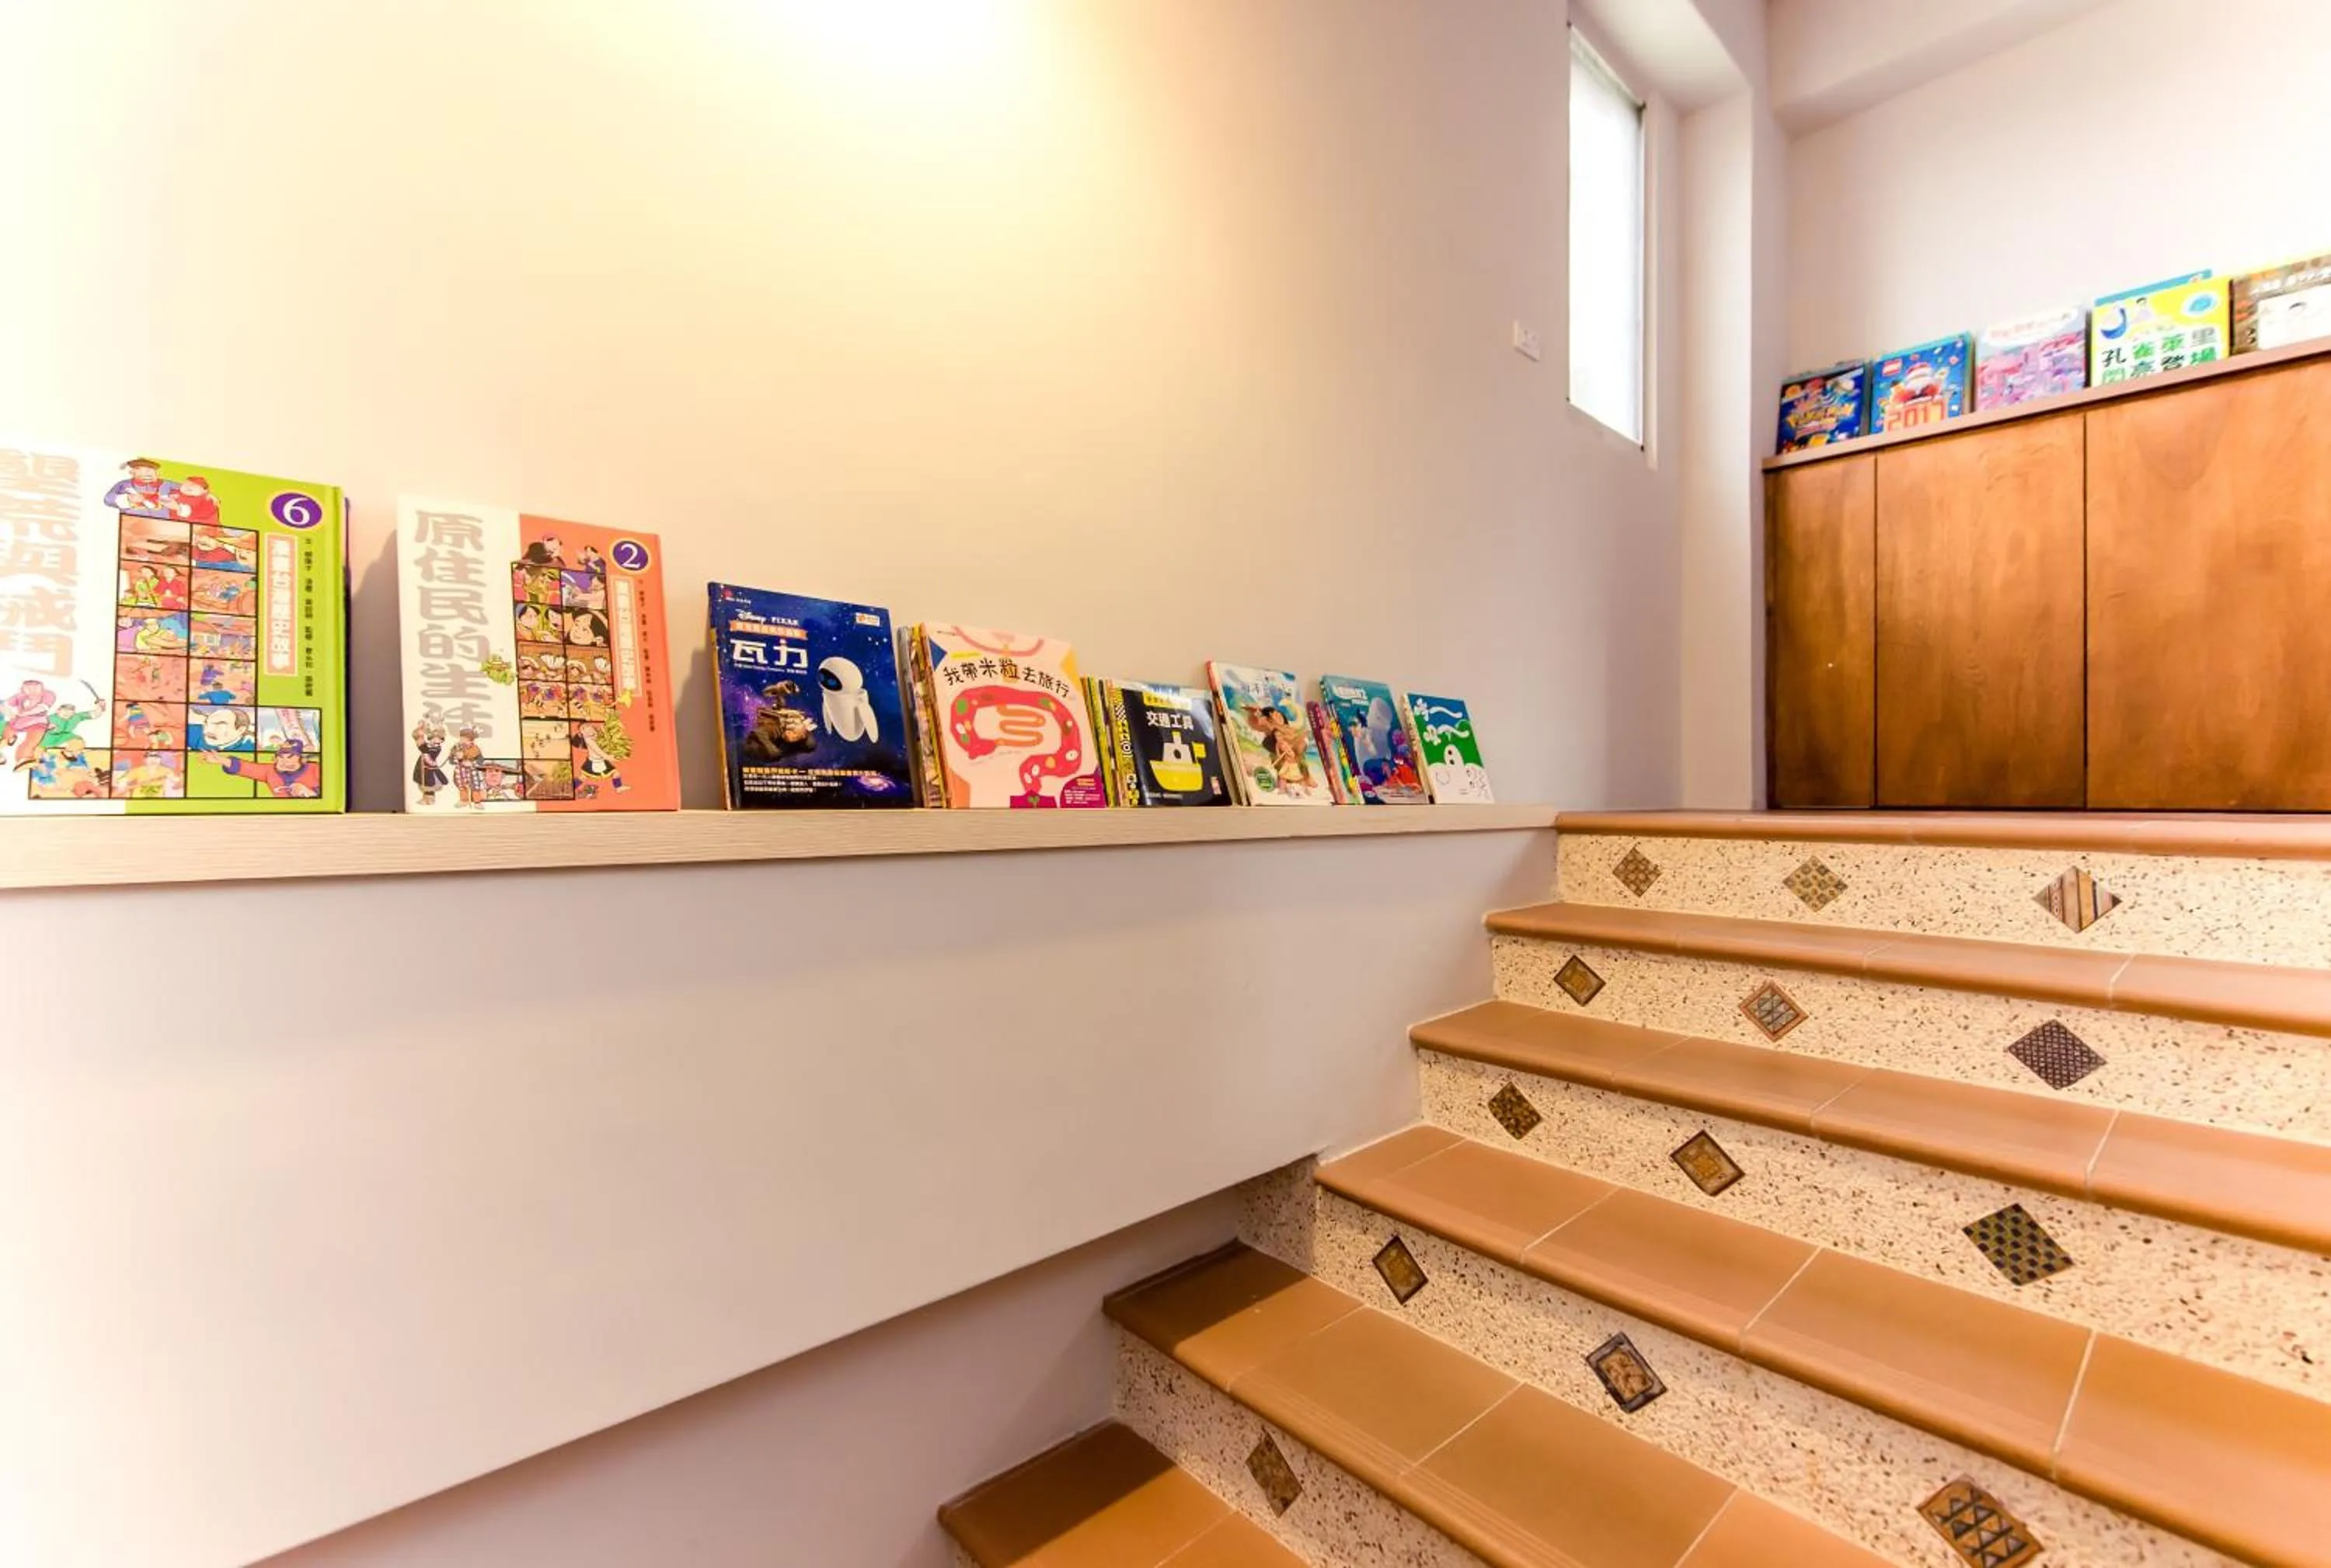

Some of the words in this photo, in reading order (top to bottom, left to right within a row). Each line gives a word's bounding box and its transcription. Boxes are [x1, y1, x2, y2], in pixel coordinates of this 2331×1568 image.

[1887, 398, 1946, 432] 2017
[282, 496, 311, 528] 6
[620, 544, 641, 570] 2
[413, 510, 493, 740] 原住民的生活
[730, 637, 809, 670] 瓦力
[943, 657, 1070, 698] 我帶米粒去旅行
[1145, 710, 1202, 731] 交通工具
